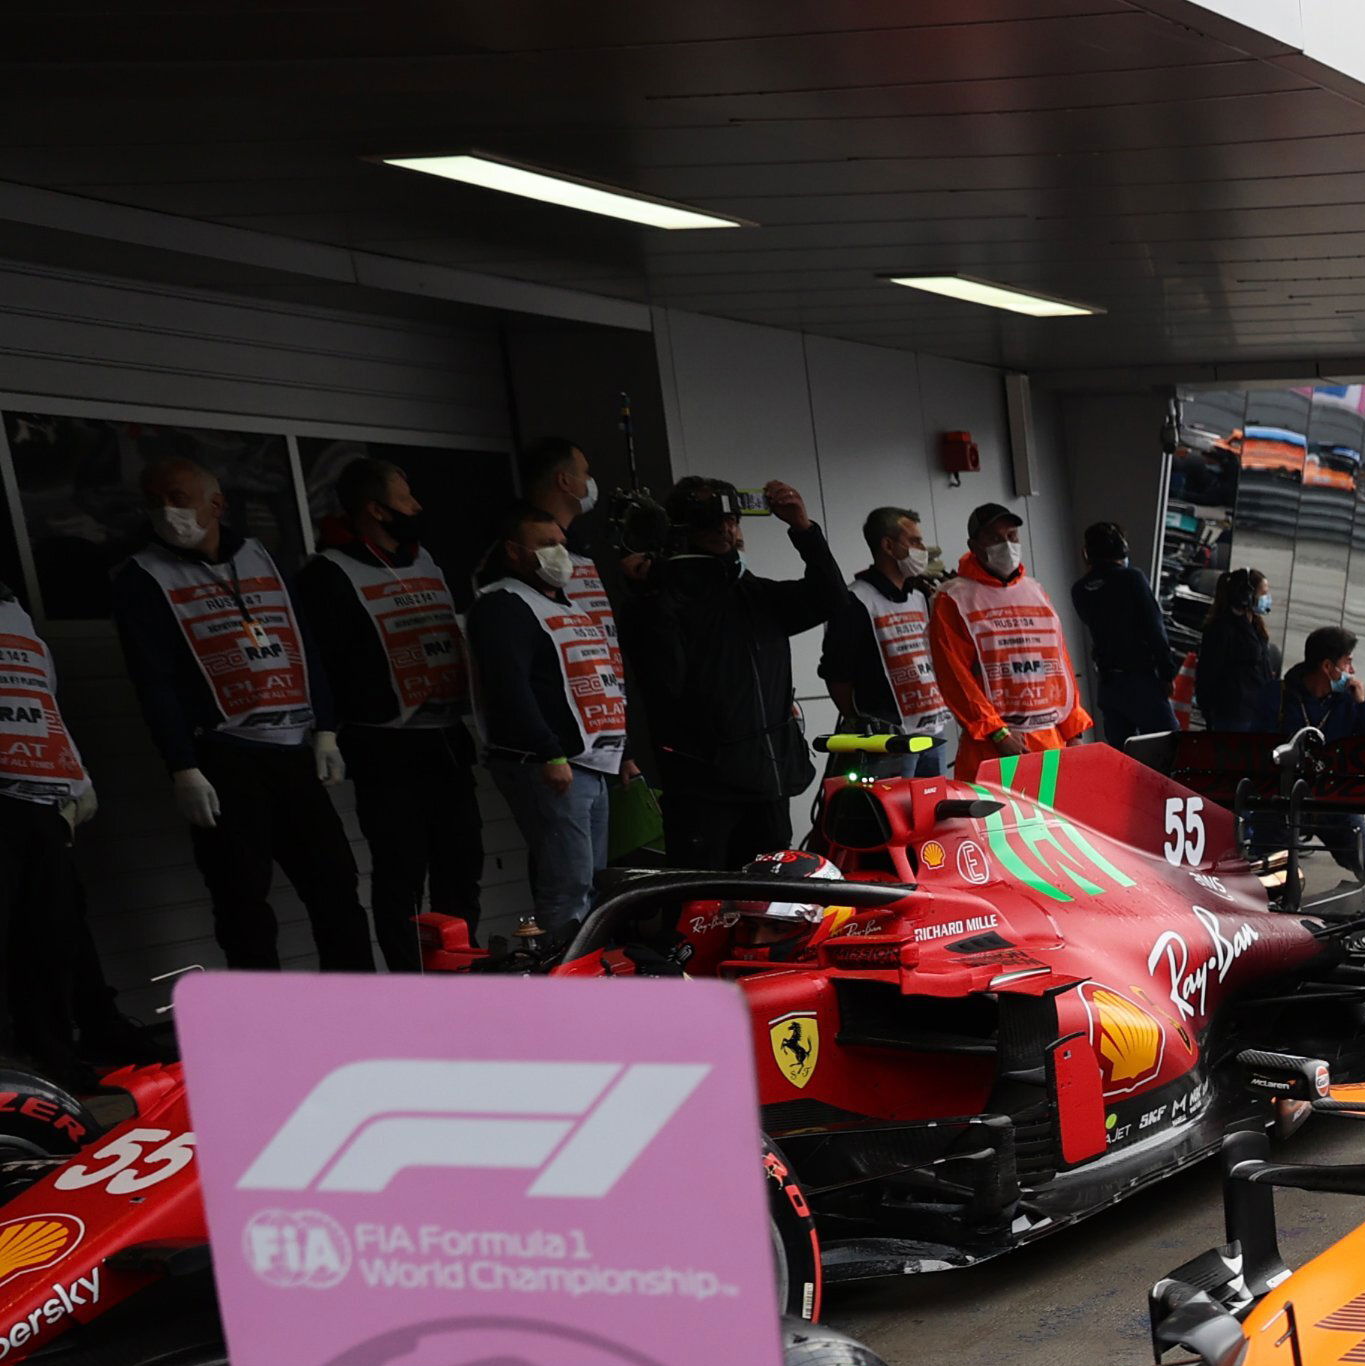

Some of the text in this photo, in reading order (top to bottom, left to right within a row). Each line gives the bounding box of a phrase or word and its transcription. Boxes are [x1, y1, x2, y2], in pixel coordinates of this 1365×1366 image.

[1011, 661, 1041, 673] RAF
[1164, 797, 1206, 866] 55
[914, 914, 998, 942] RICHARD MILLE
[1250, 1078, 1291, 1090] McLaren
[1139, 1104, 1167, 1130] SKF
[54, 1128, 198, 1195] 55
[357, 1223, 414, 1256] FIA
[419, 1226, 569, 1259] Formula
[572, 1230, 592, 1258] 1
[359, 1257, 463, 1289] World
